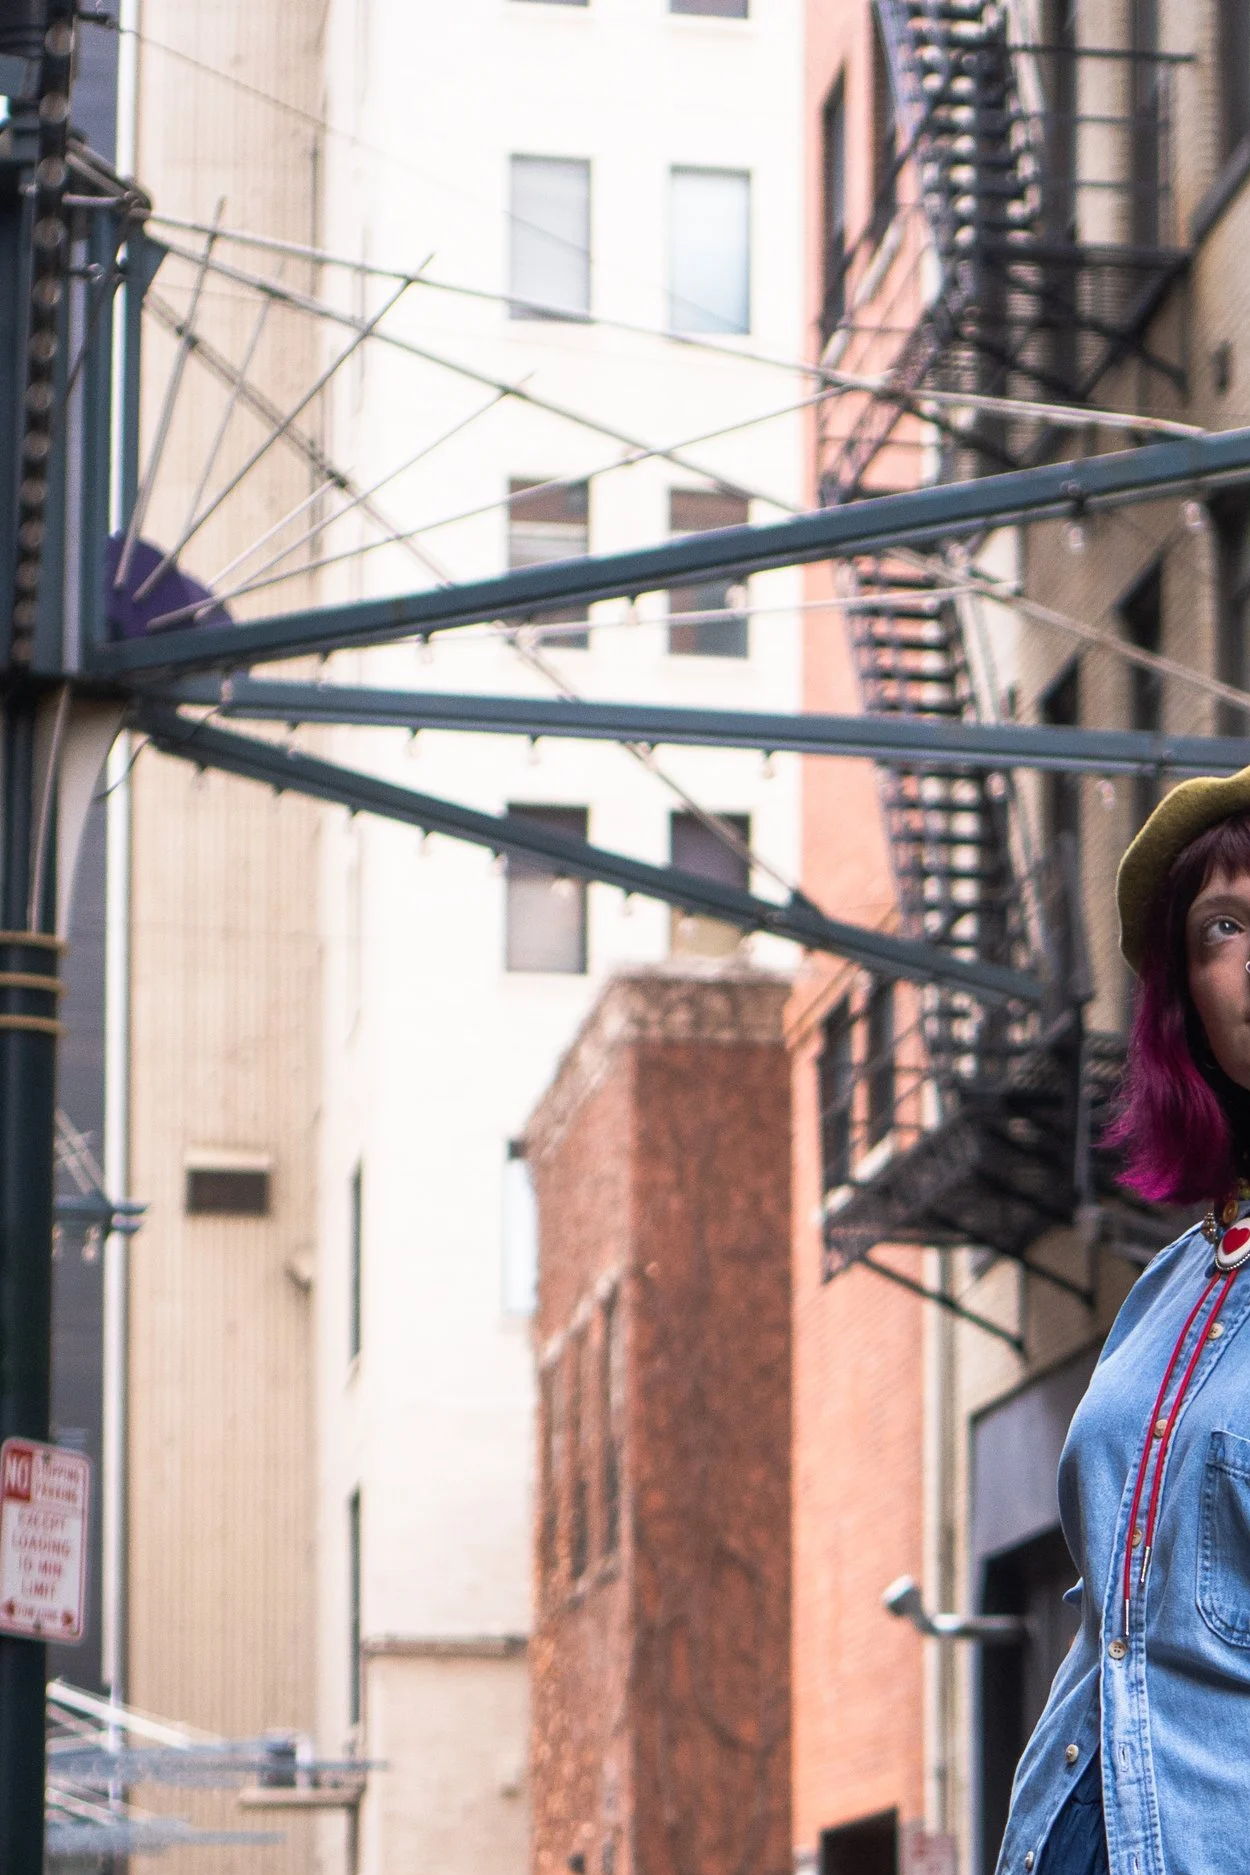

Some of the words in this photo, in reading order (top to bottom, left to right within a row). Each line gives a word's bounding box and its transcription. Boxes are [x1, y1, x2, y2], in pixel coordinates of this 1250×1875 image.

[5, 1453, 30, 1490] NO
[19, 1508, 66, 1532] EXCEPT
[12, 1530, 71, 1557] LOADING
[38, 1559, 62, 1577] MIN
[22, 1579, 55, 1600] LIMIT
